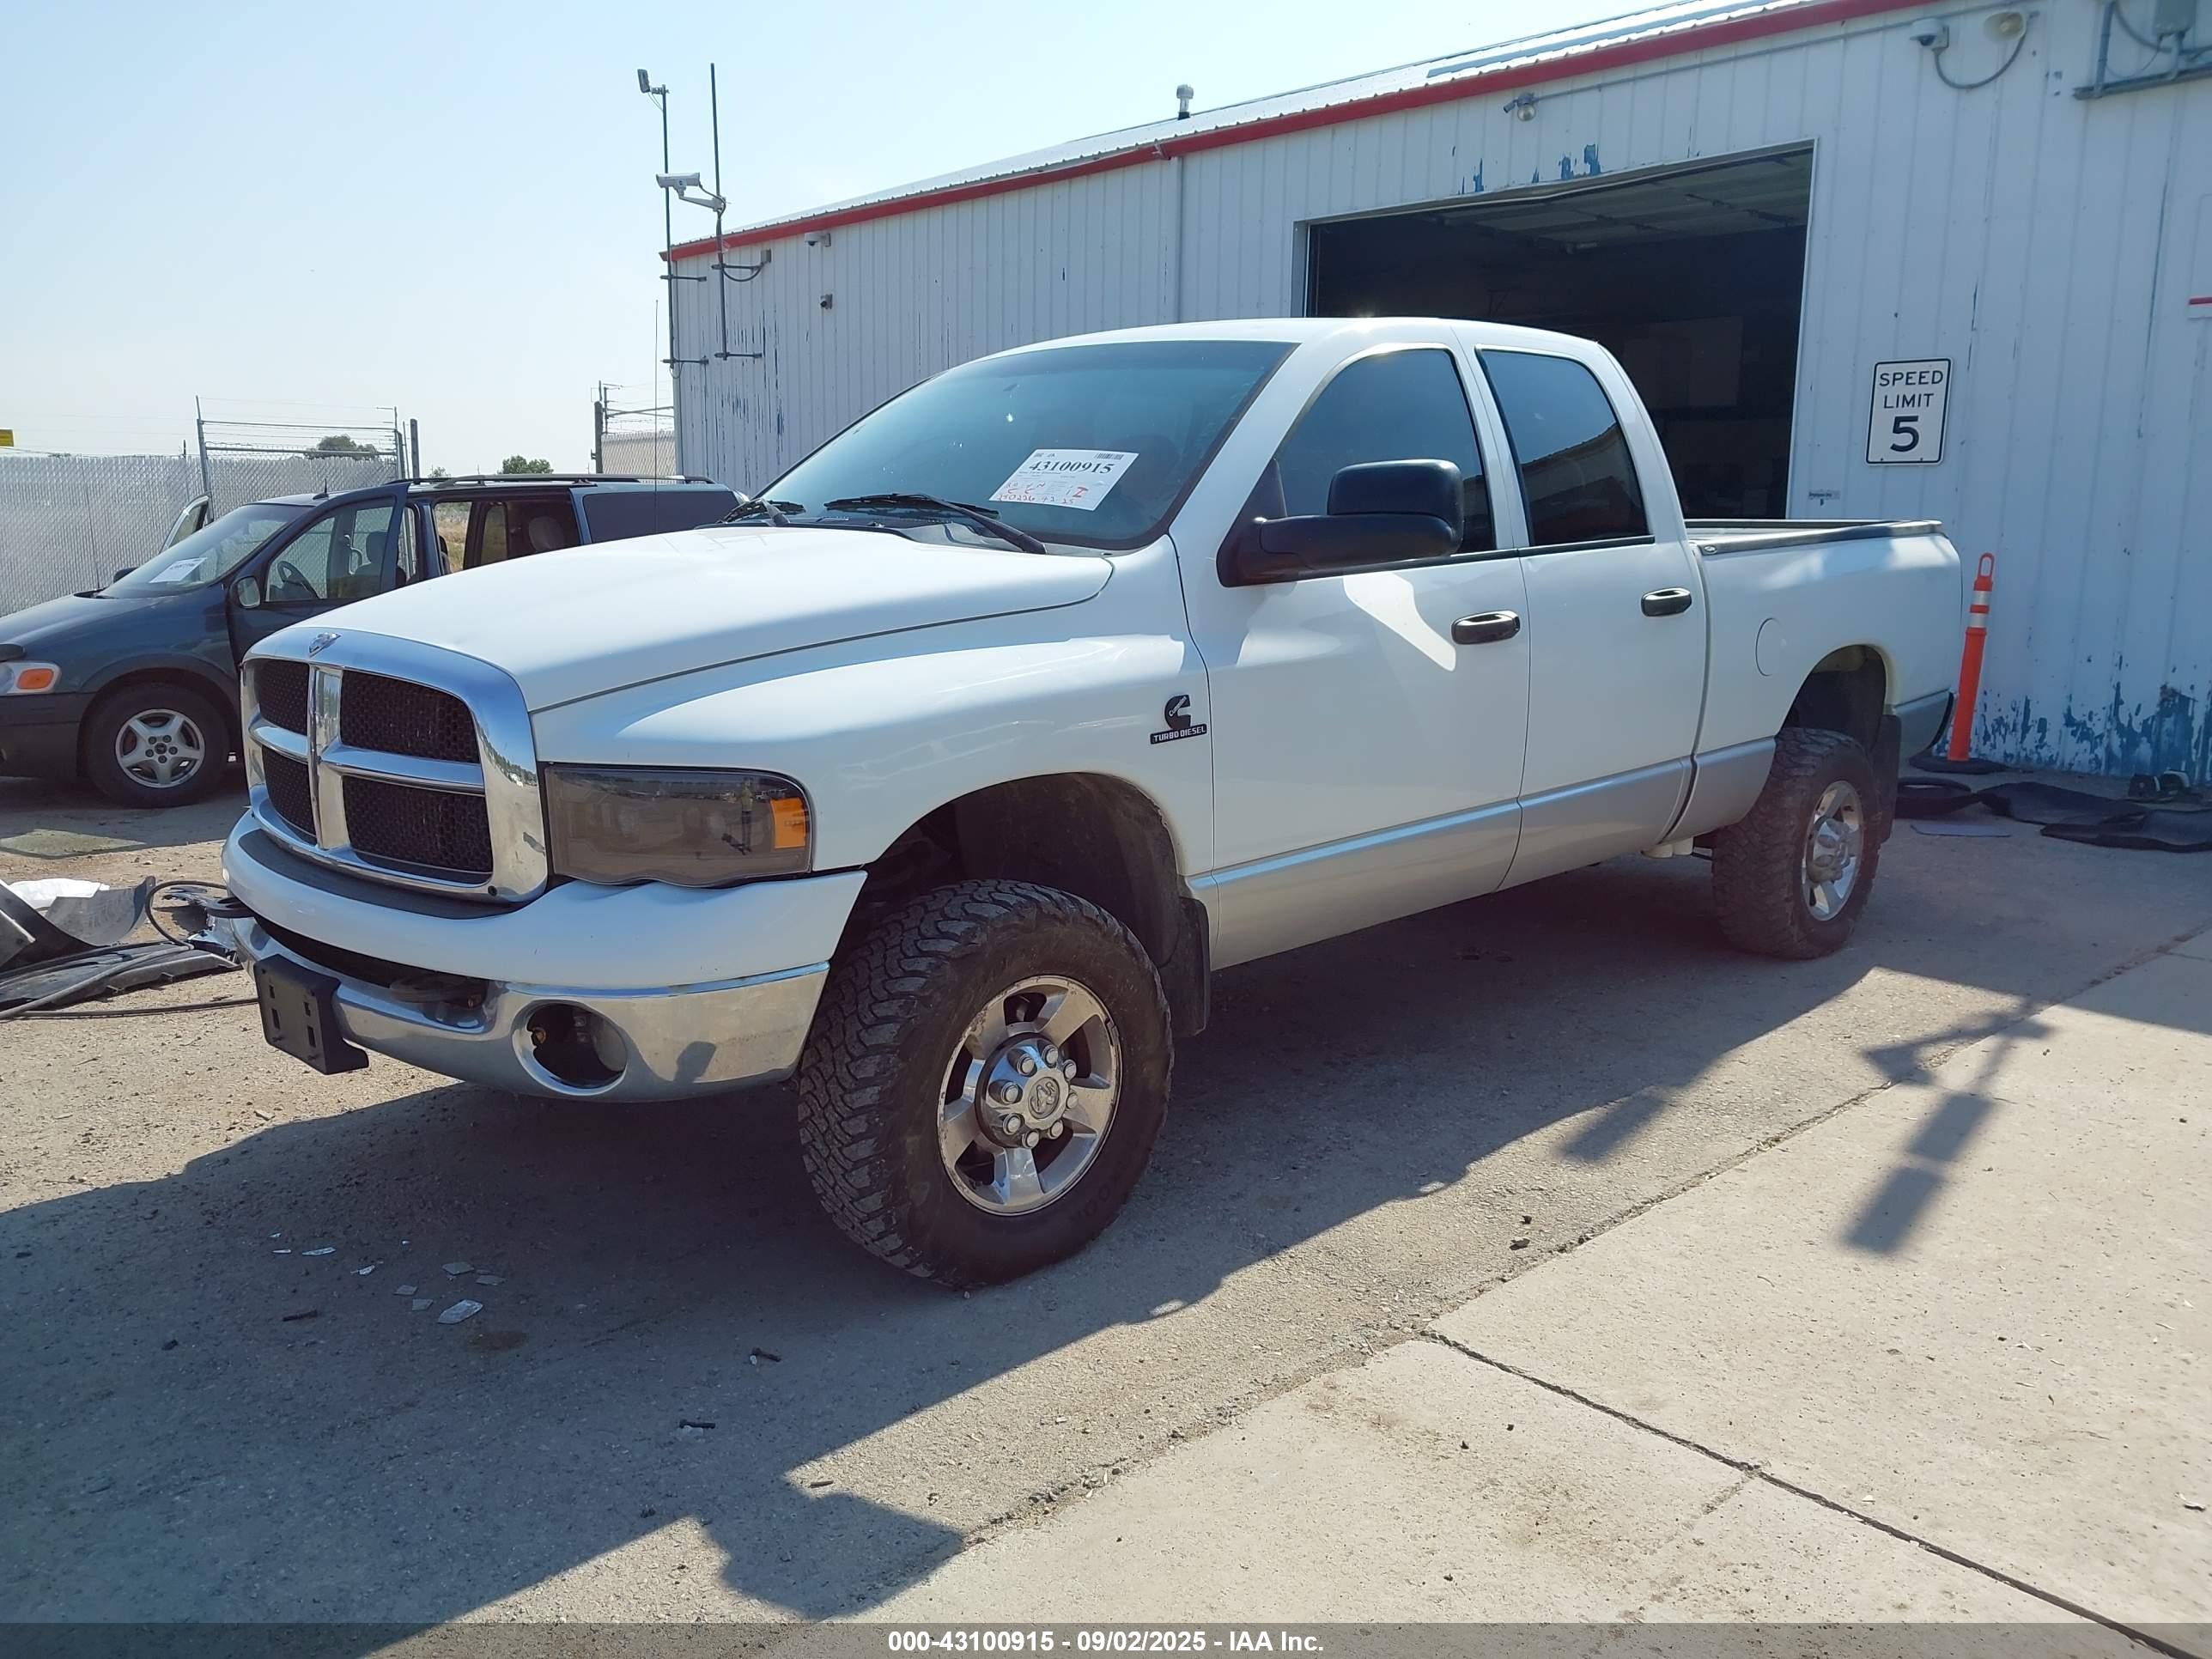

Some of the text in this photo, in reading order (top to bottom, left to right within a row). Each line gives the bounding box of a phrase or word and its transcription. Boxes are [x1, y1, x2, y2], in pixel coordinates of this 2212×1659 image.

[1879, 370, 1943, 386] SPEED
[1883, 393, 1935, 409] LIMIT
[1890, 416, 1919, 453] 5
[1029, 460, 1115, 474] 43100915
[1153, 726, 1206, 743] TURBO DIESEL
